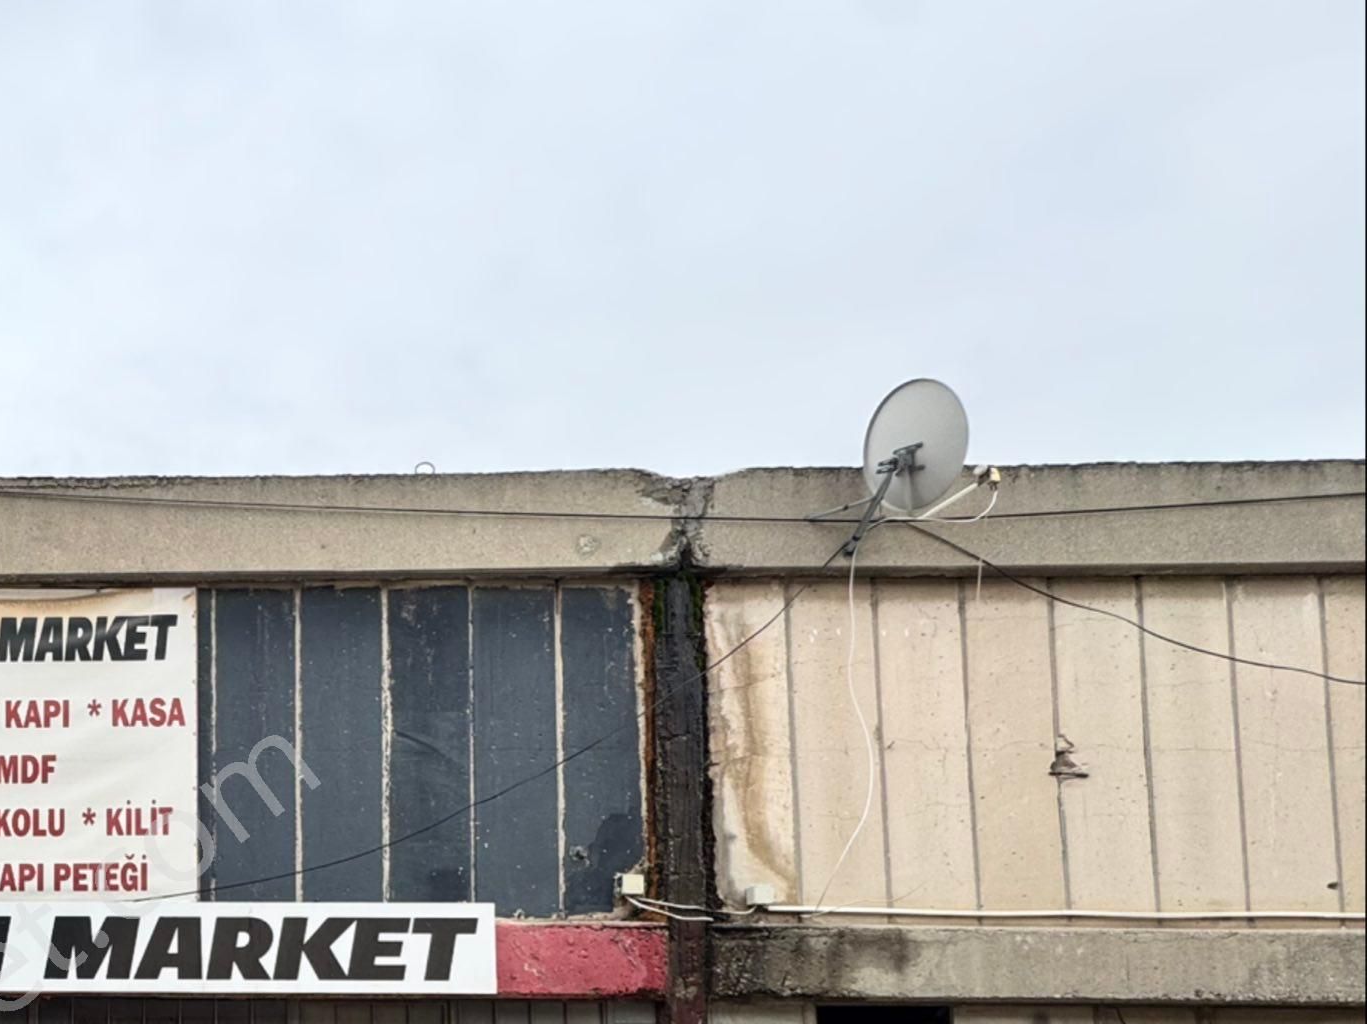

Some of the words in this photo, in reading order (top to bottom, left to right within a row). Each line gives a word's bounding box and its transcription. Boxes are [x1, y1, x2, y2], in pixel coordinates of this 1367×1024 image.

[5, 699, 70, 729] KAPI
[111, 697, 187, 727] KASA
[105, 800, 174, 836] KİLİT
[52, 853, 149, 892] PETEĞİ
[43, 916, 479, 981] MARKET
